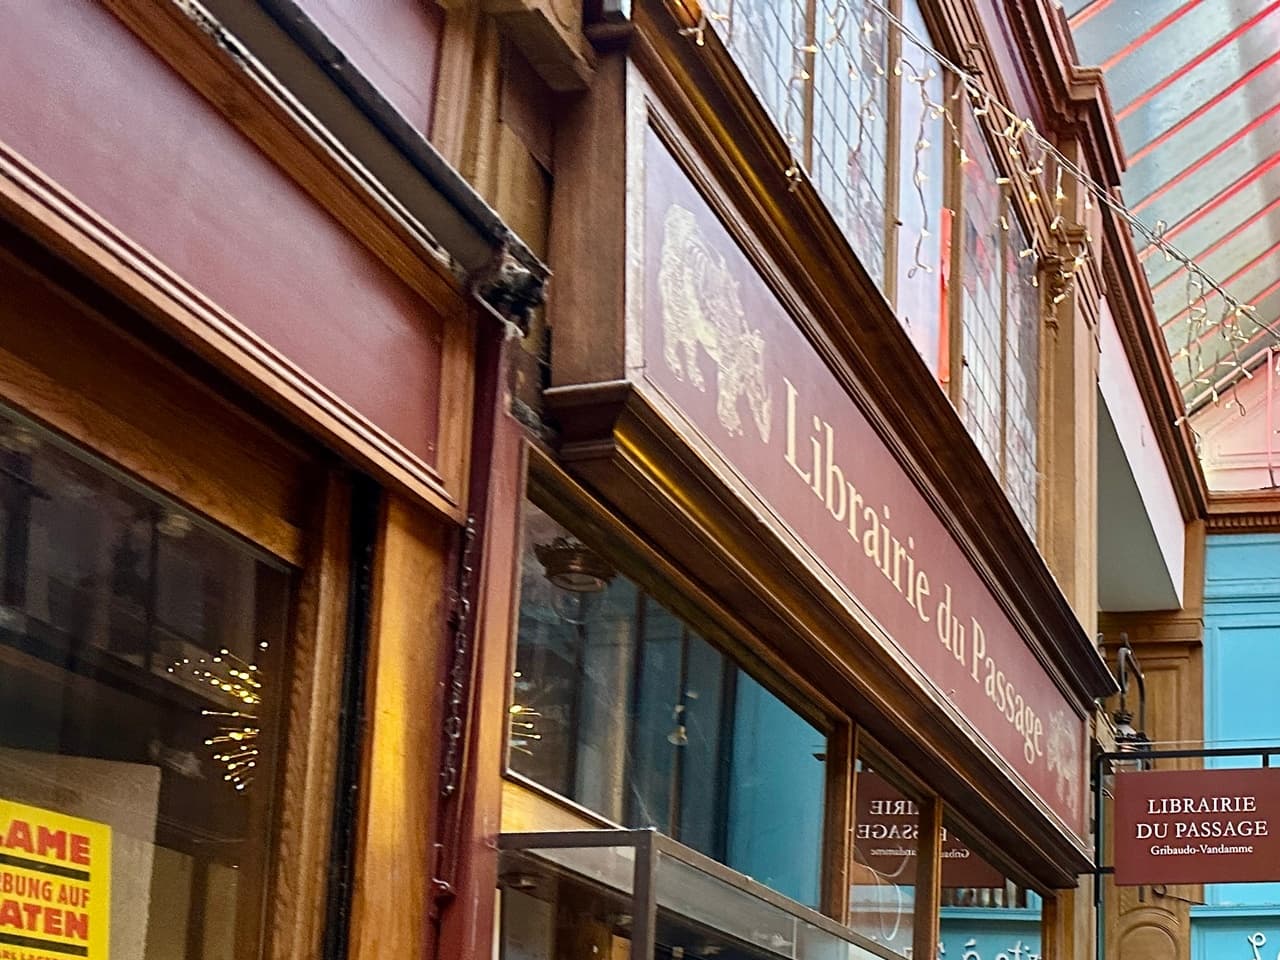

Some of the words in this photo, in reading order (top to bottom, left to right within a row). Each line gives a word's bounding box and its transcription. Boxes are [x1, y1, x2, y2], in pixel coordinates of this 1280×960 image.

[783, 376, 930, 622] Librairie
[937, 584, 965, 667] du
[971, 616, 1043, 764] Passage
[1147, 796, 1257, 814] LIBRAIRIE
[0, 819, 91, 866] AME
[1136, 823, 1168, 839] DU
[1175, 820, 1269, 838] PASSAGE
[1150, 843, 1253, 855] Gribaudo-Vandamme
[0, 871, 52, 902] BUNG
[58, 883, 90, 909] AUF
